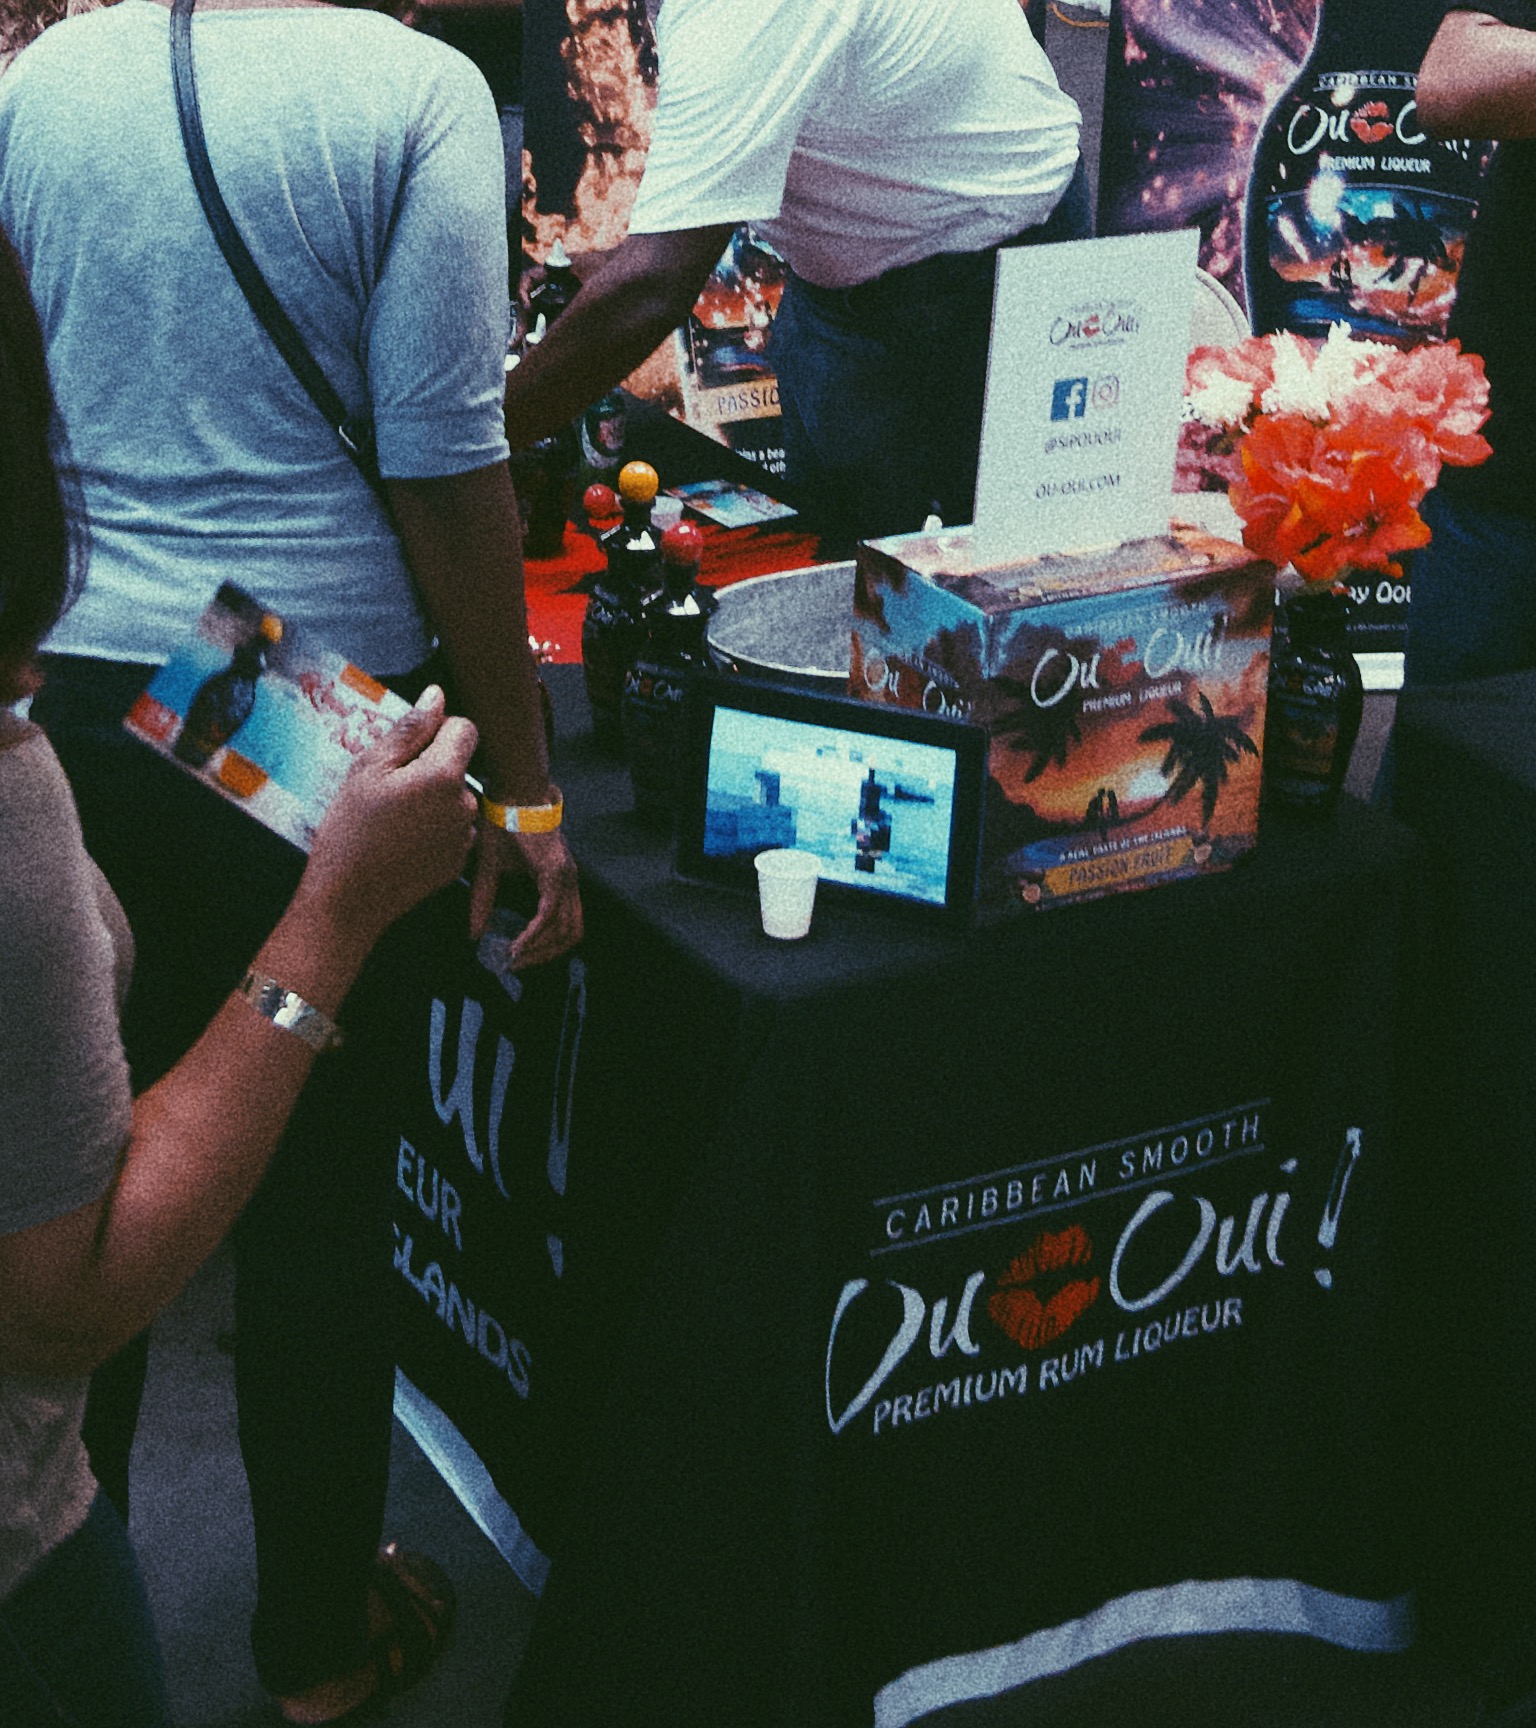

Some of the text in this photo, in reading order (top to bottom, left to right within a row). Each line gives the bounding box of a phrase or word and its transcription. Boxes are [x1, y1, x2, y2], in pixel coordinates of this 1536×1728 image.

[1287, 104, 1350, 155] Ou
[1381, 157, 1431, 173] LIQUEUR
[1030, 647, 1101, 708] Ou
[885, 1112, 1261, 1242] CARIBBEAN SMOOTH
[825, 1271, 986, 1435] Ou
[873, 1296, 1243, 1435] PREMIUM RUM LIQUEUR
